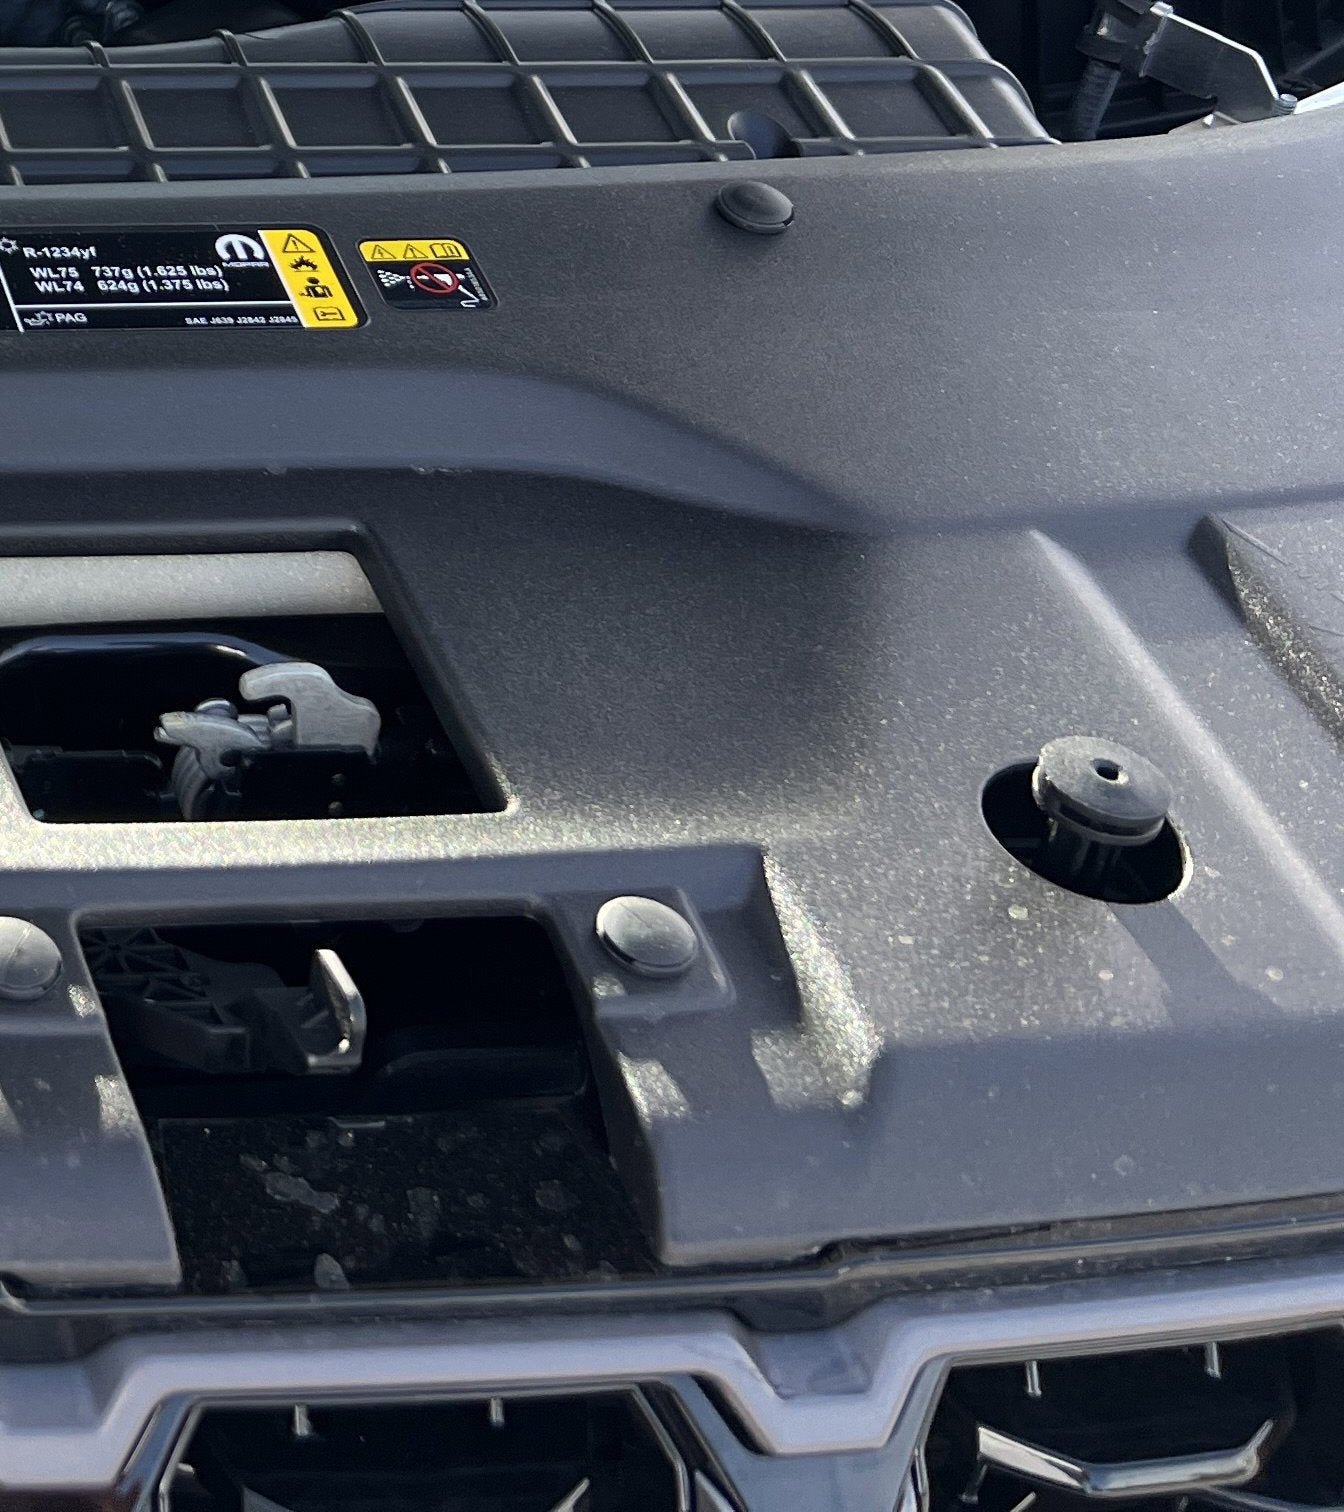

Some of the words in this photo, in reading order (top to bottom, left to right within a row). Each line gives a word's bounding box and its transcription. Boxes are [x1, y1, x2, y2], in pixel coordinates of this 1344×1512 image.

[22, 245, 97, 260] R-1234yf
[29, 266, 80, 279] WL75
[90, 265, 134, 280] 737g
[136, 265, 187, 279] (1.625
[189, 264, 224, 278] lbs)
[34, 280, 85, 293] WL74
[97, 280, 140, 294] 624g
[142, 279, 194, 293] (1.375
[196, 278, 230, 292] lbs)
[54, 312, 88, 324] PAG
